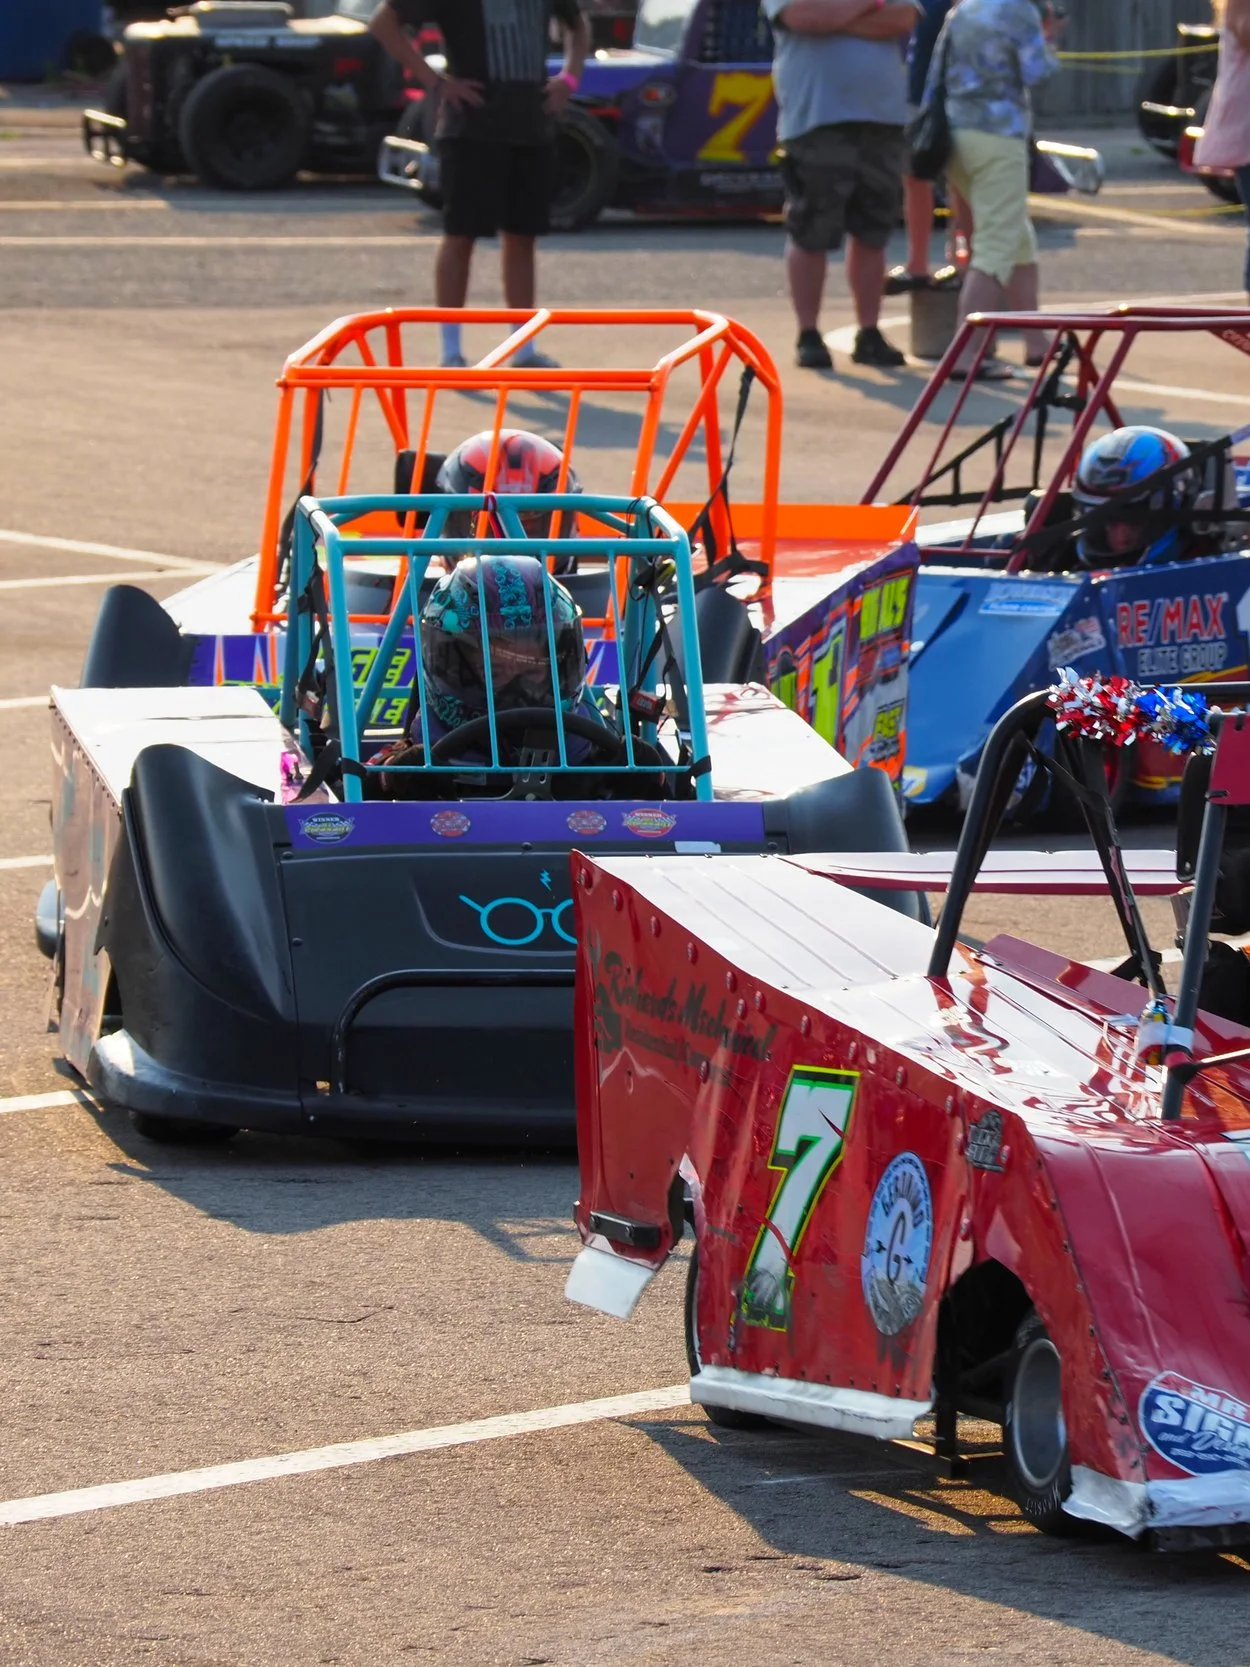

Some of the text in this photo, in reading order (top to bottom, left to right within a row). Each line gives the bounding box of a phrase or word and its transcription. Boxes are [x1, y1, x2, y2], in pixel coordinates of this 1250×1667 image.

[1117, 593, 1227, 648] RE/MAX
[1137, 641, 1227, 677] ELITE GROUP
[738, 1065, 861, 1332] 7
